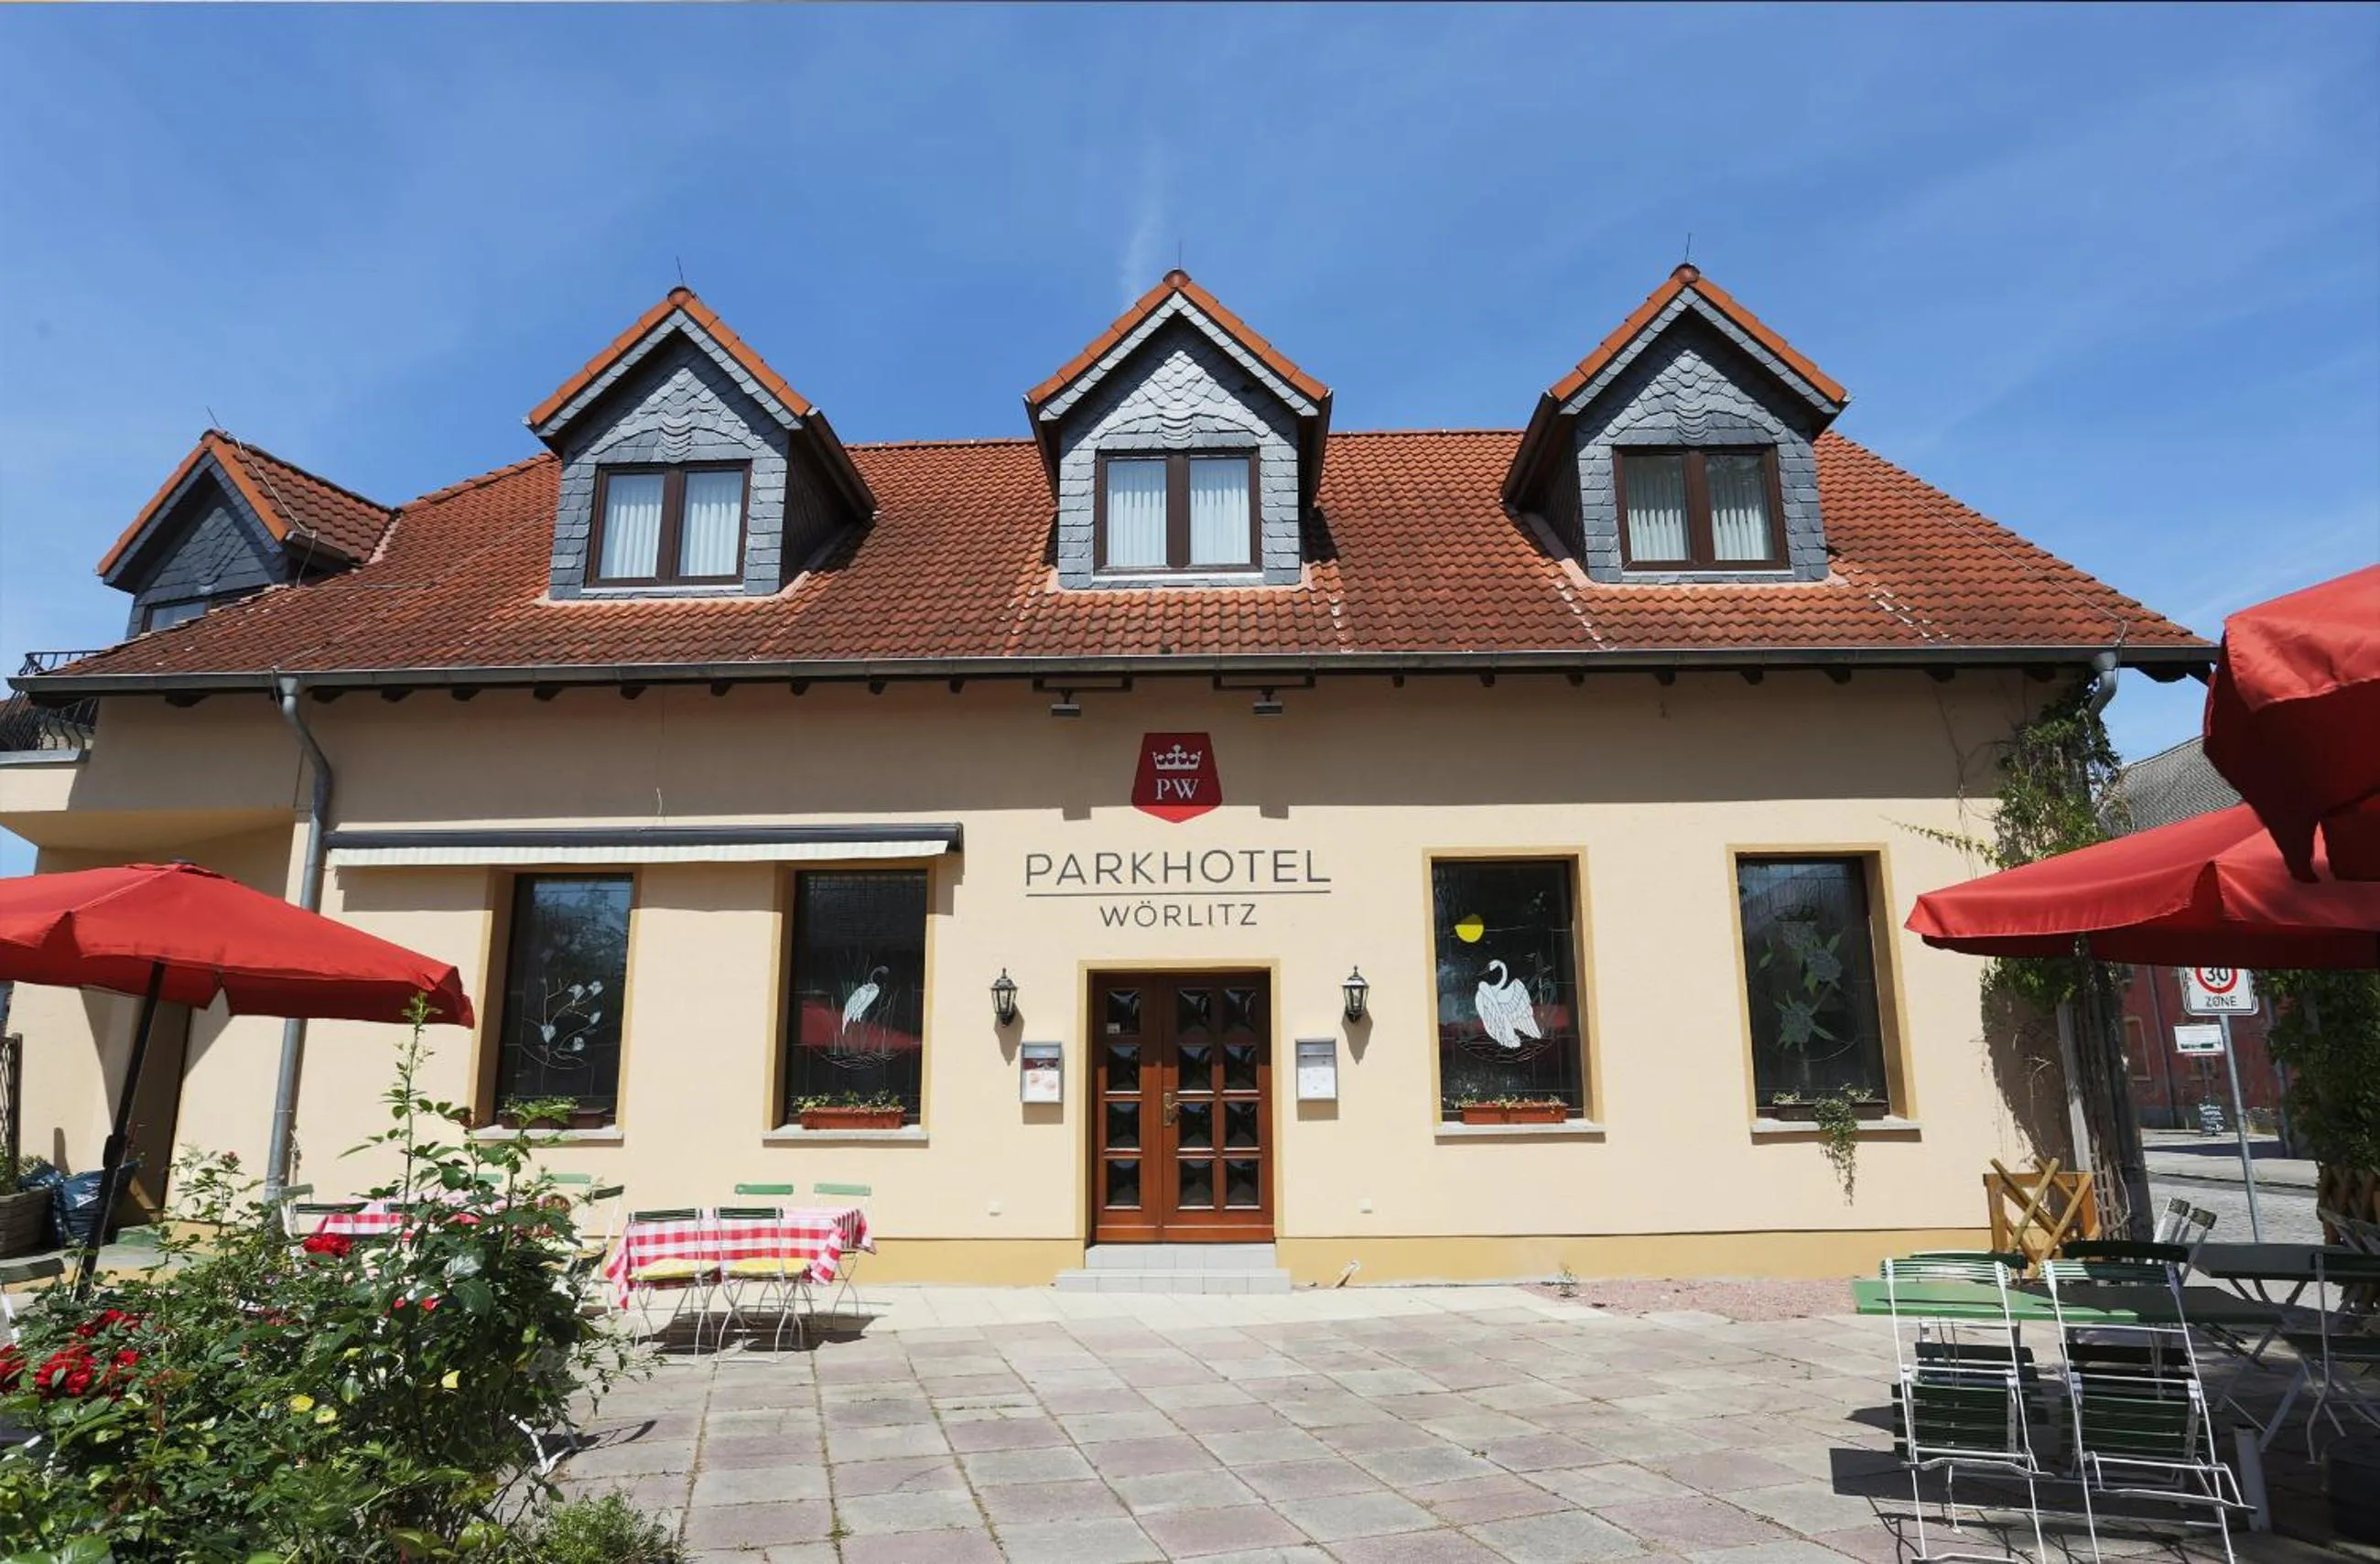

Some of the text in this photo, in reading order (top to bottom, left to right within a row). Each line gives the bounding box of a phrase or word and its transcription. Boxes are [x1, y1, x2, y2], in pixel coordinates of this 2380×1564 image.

[1156, 778, 1199, 800] PW
[1025, 849, 1331, 886] PARKHOTEL
[1099, 901, 1257, 927] WÖRLITZ
[2205, 966, 2229, 982] 30
[2205, 996, 2237, 1008] ZONE
